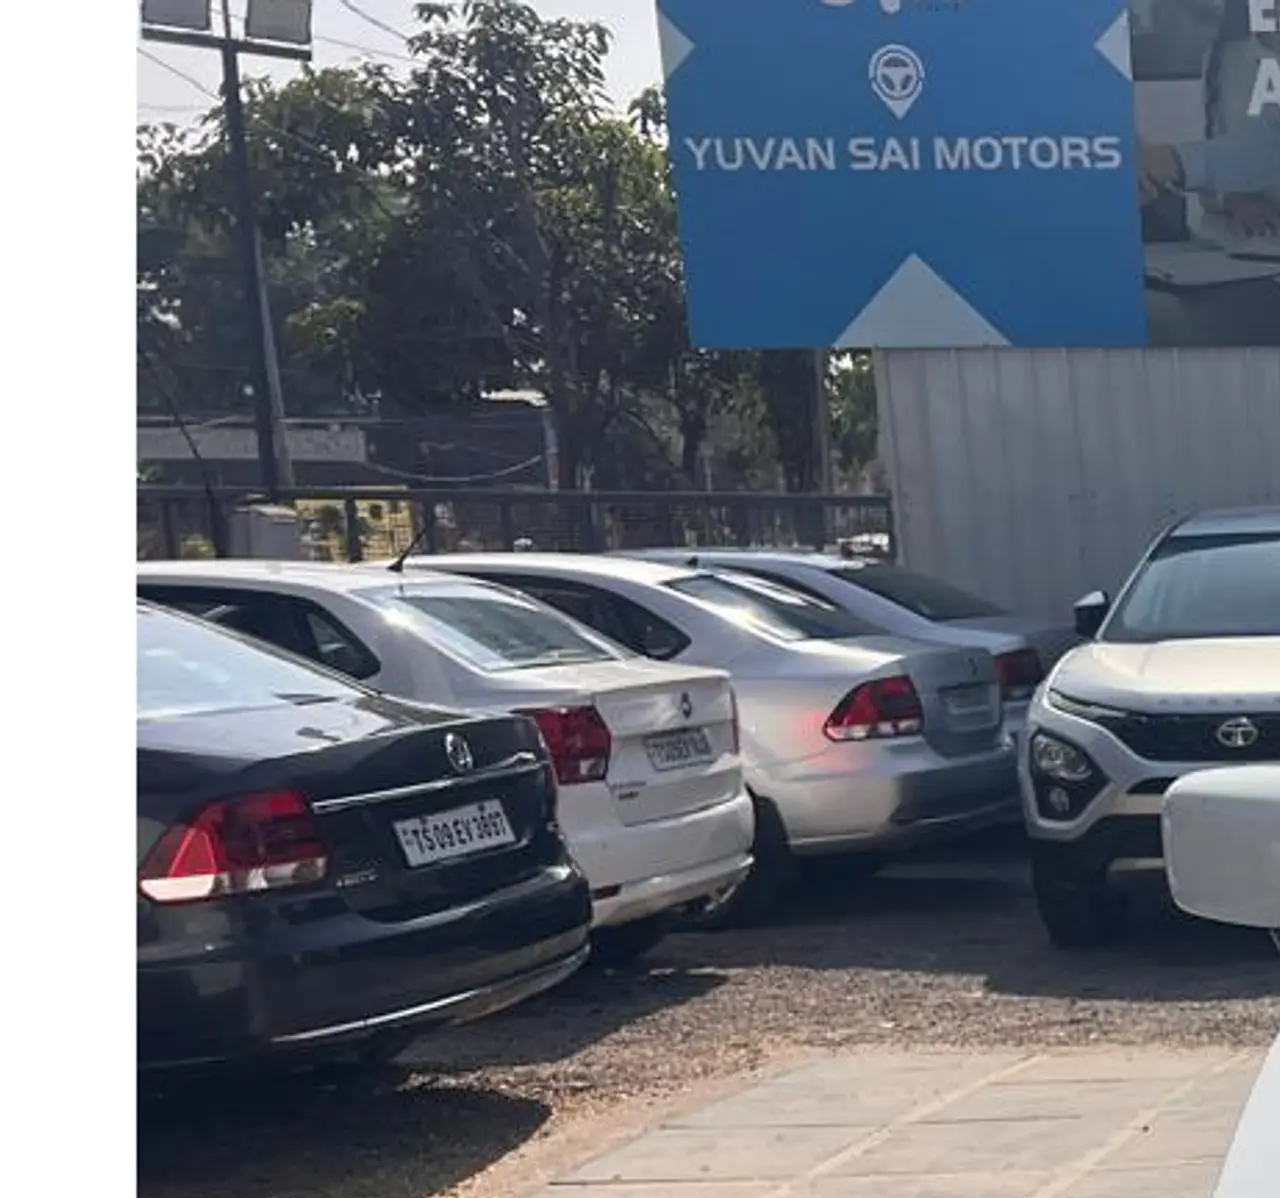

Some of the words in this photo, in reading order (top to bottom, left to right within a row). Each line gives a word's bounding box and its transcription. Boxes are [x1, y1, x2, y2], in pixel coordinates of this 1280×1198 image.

[684, 136, 837, 171] YUVAN
[849, 136, 920, 171] SAI
[933, 136, 1123, 171] MOTORS
